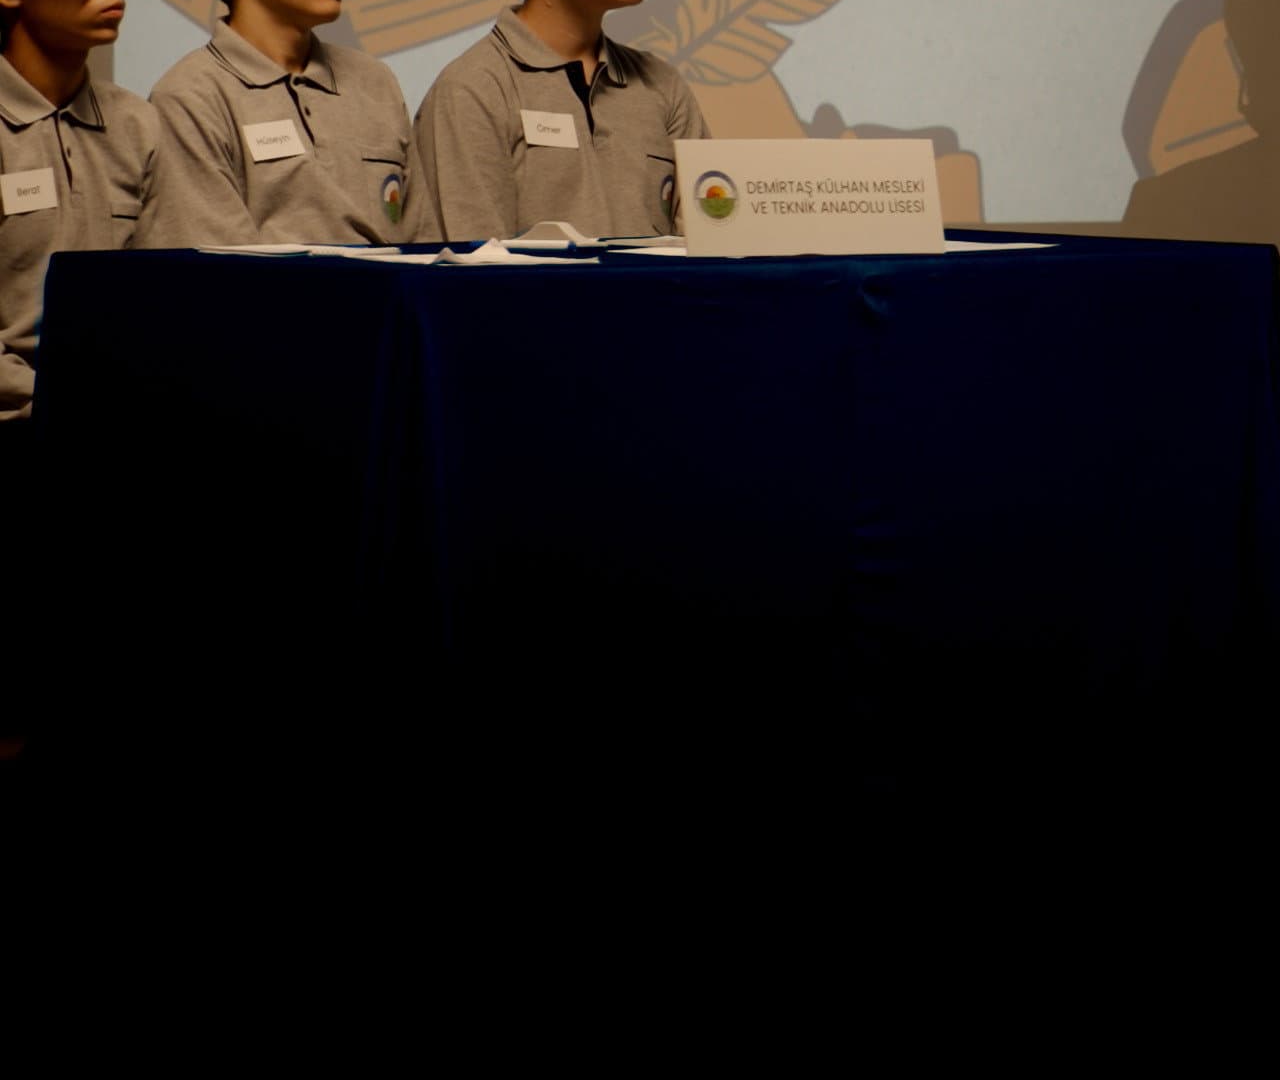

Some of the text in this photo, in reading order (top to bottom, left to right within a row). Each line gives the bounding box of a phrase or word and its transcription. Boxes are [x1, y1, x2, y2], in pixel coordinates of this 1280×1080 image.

[746, 177, 925, 198] DEMİRTAŞ KÜLHAN MESLEKİ
[750, 200, 768, 214] VE
[771, 198, 817, 215] TEKNİK
[821, 200, 885, 214] ANADOLU
